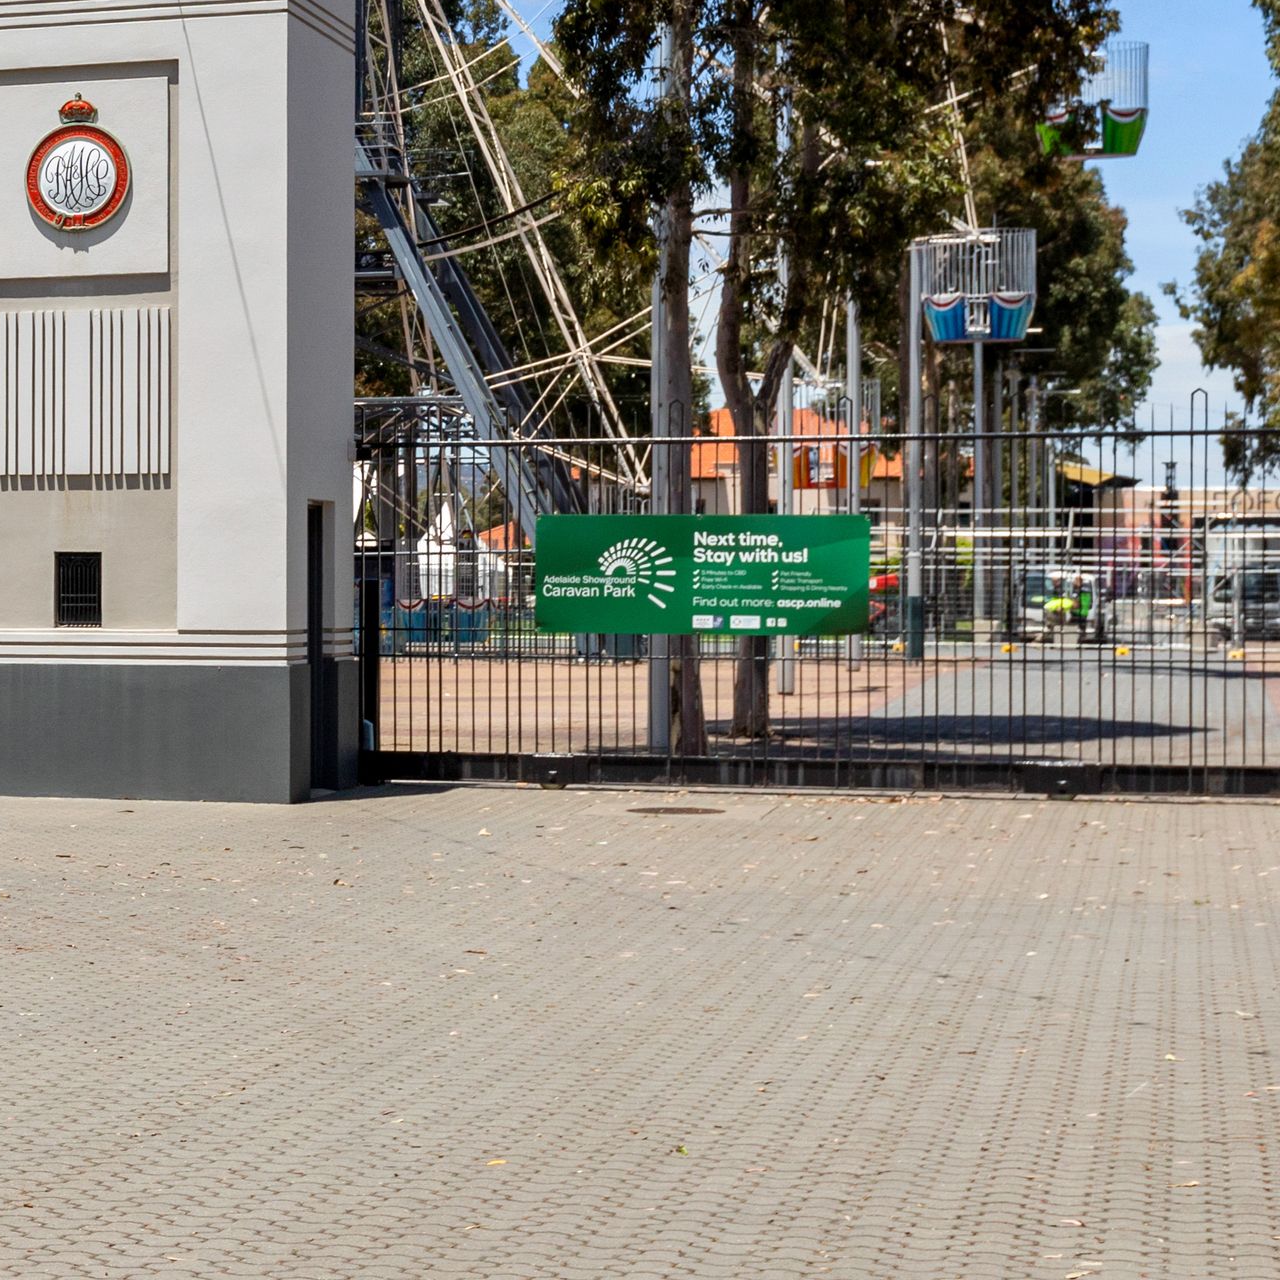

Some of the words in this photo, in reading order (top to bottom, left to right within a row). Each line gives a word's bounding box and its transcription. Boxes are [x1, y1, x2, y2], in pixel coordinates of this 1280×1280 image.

[693, 531, 736, 546] Next
[738, 531, 784, 548] time,
[693, 548, 737, 566] Stay
[739, 548, 779, 563] with
[782, 548, 809, 563] us!
[543, 575, 581, 584] Adelaide
[582, 575, 637, 586] Showground
[542, 584, 600, 597] Caravan
[603, 584, 636, 597] Park
[692, 596, 717, 607] Find
[719, 597, 739, 607] out
[741, 598, 776, 608] more:
[777, 597, 842, 610] ascp.online
